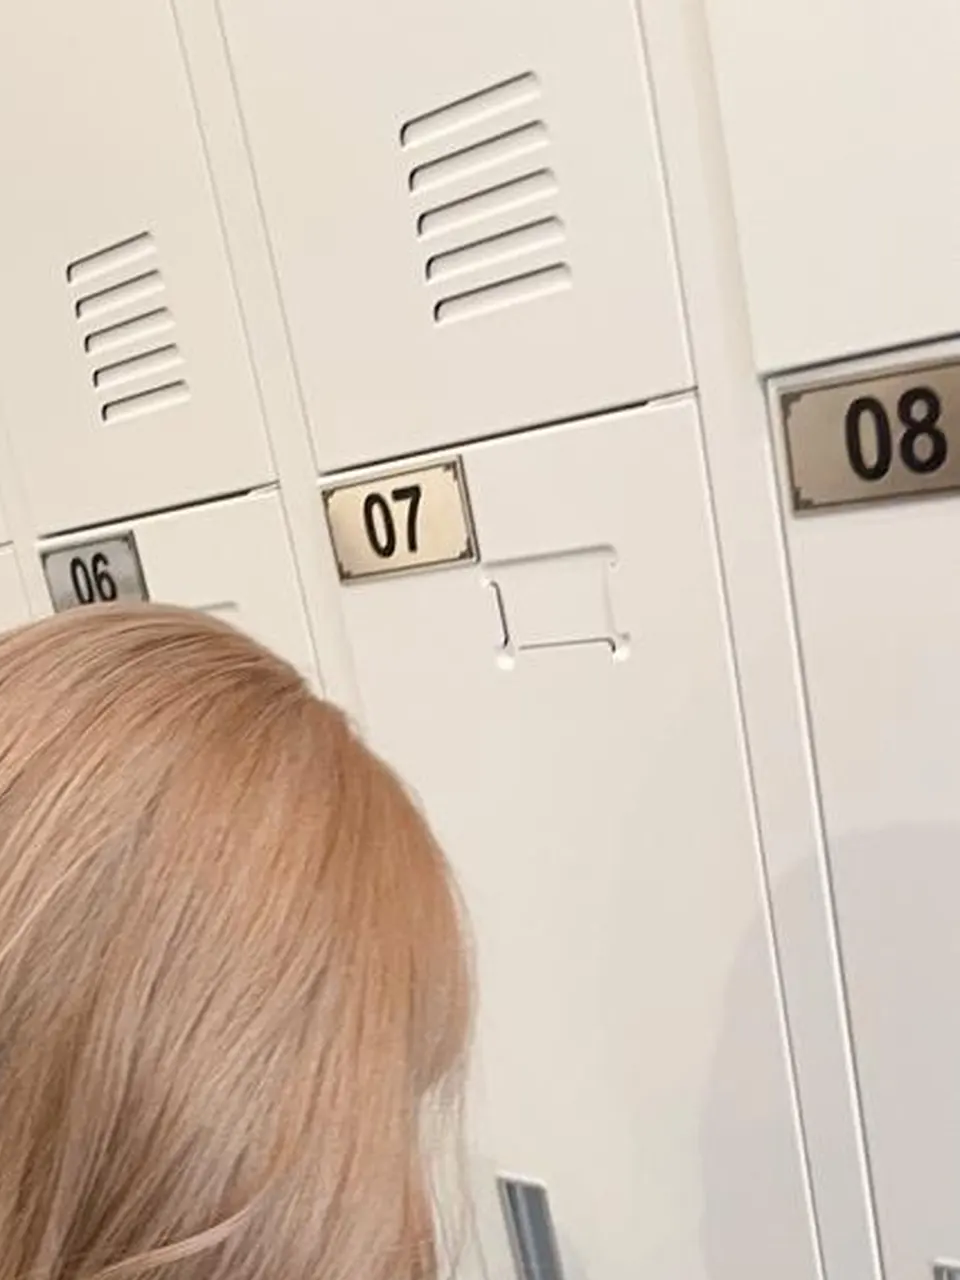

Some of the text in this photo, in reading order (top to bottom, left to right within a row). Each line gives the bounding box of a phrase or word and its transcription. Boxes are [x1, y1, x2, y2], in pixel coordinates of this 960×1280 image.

[845, 386, 948, 481] 08
[363, 484, 422, 558] 07
[70, 552, 118, 605] 06
